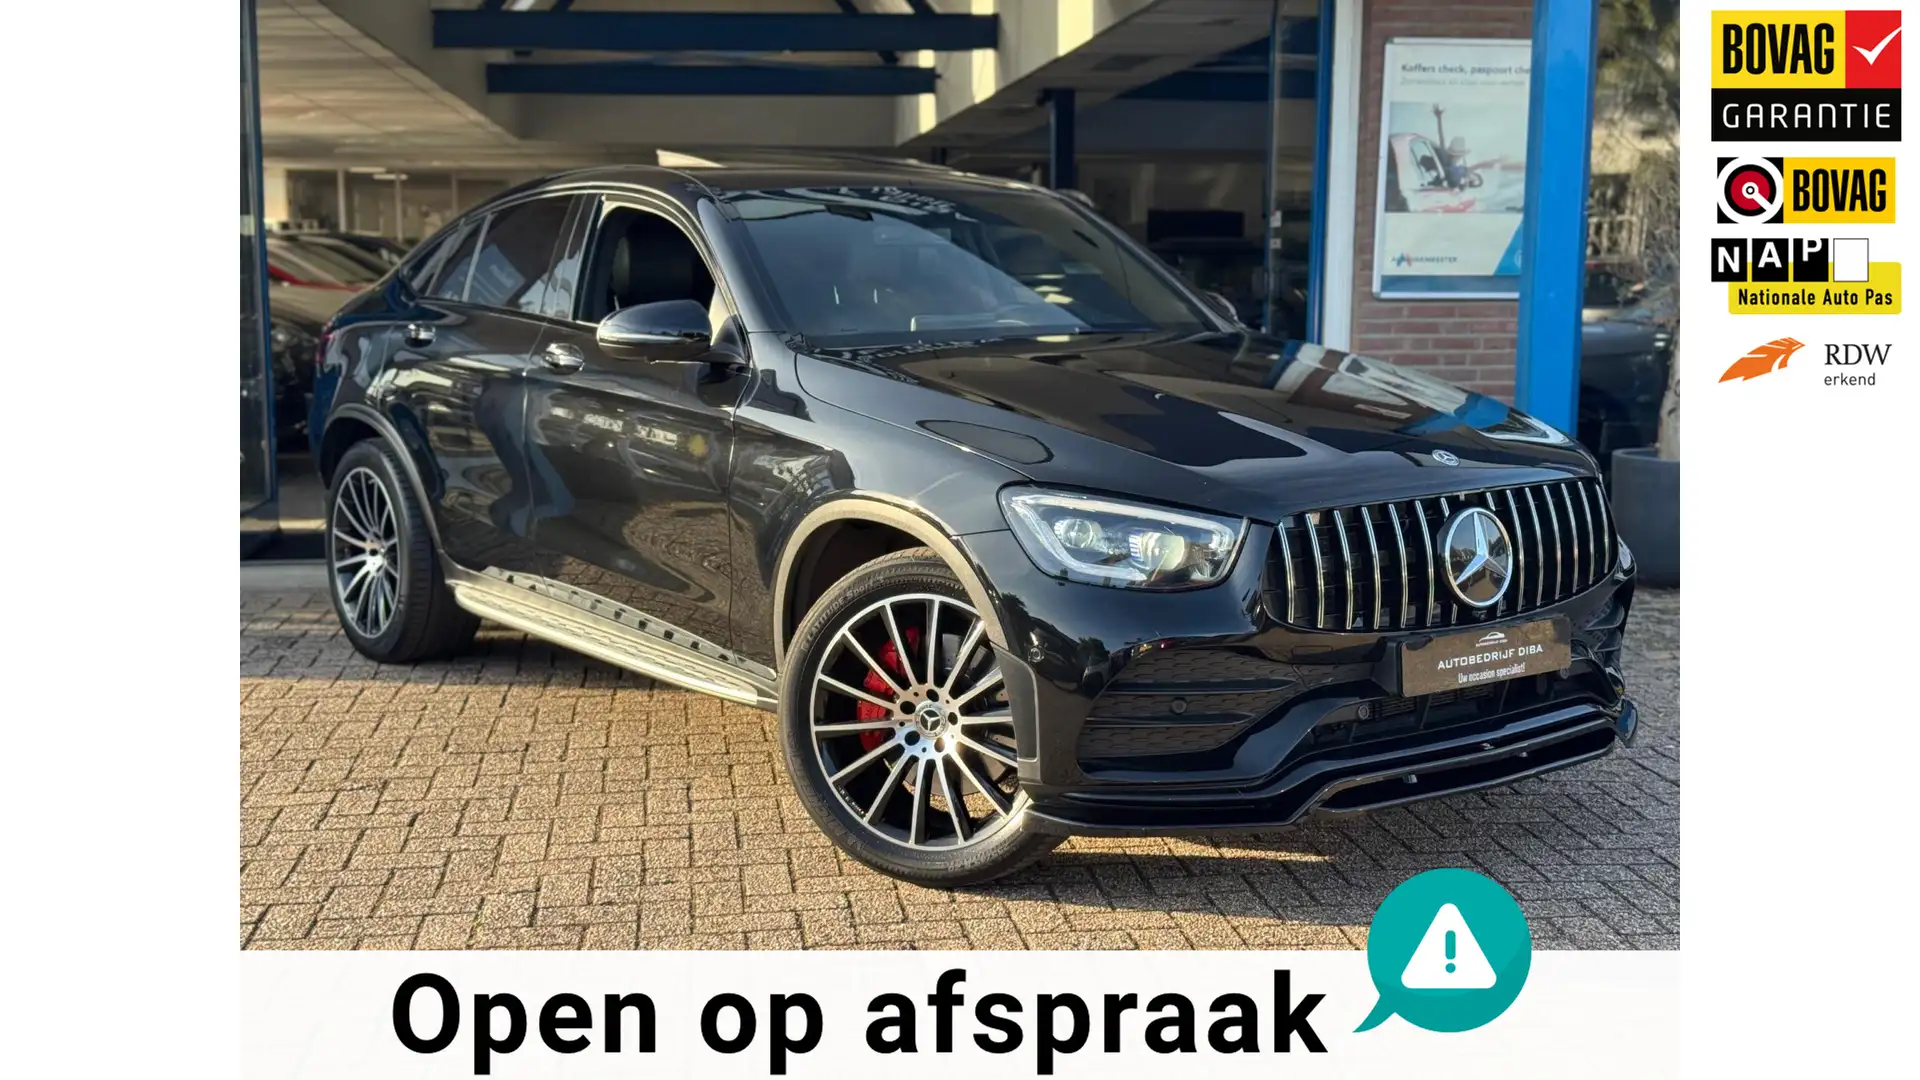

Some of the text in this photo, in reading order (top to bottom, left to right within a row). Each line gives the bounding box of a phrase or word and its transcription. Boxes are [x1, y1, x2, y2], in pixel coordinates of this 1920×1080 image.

[1437, 644, 1543, 670] AUTOBEDRIJF DIBA
[1458, 671, 1468, 683] Uw
[1468, 668, 1496, 682] occasion
